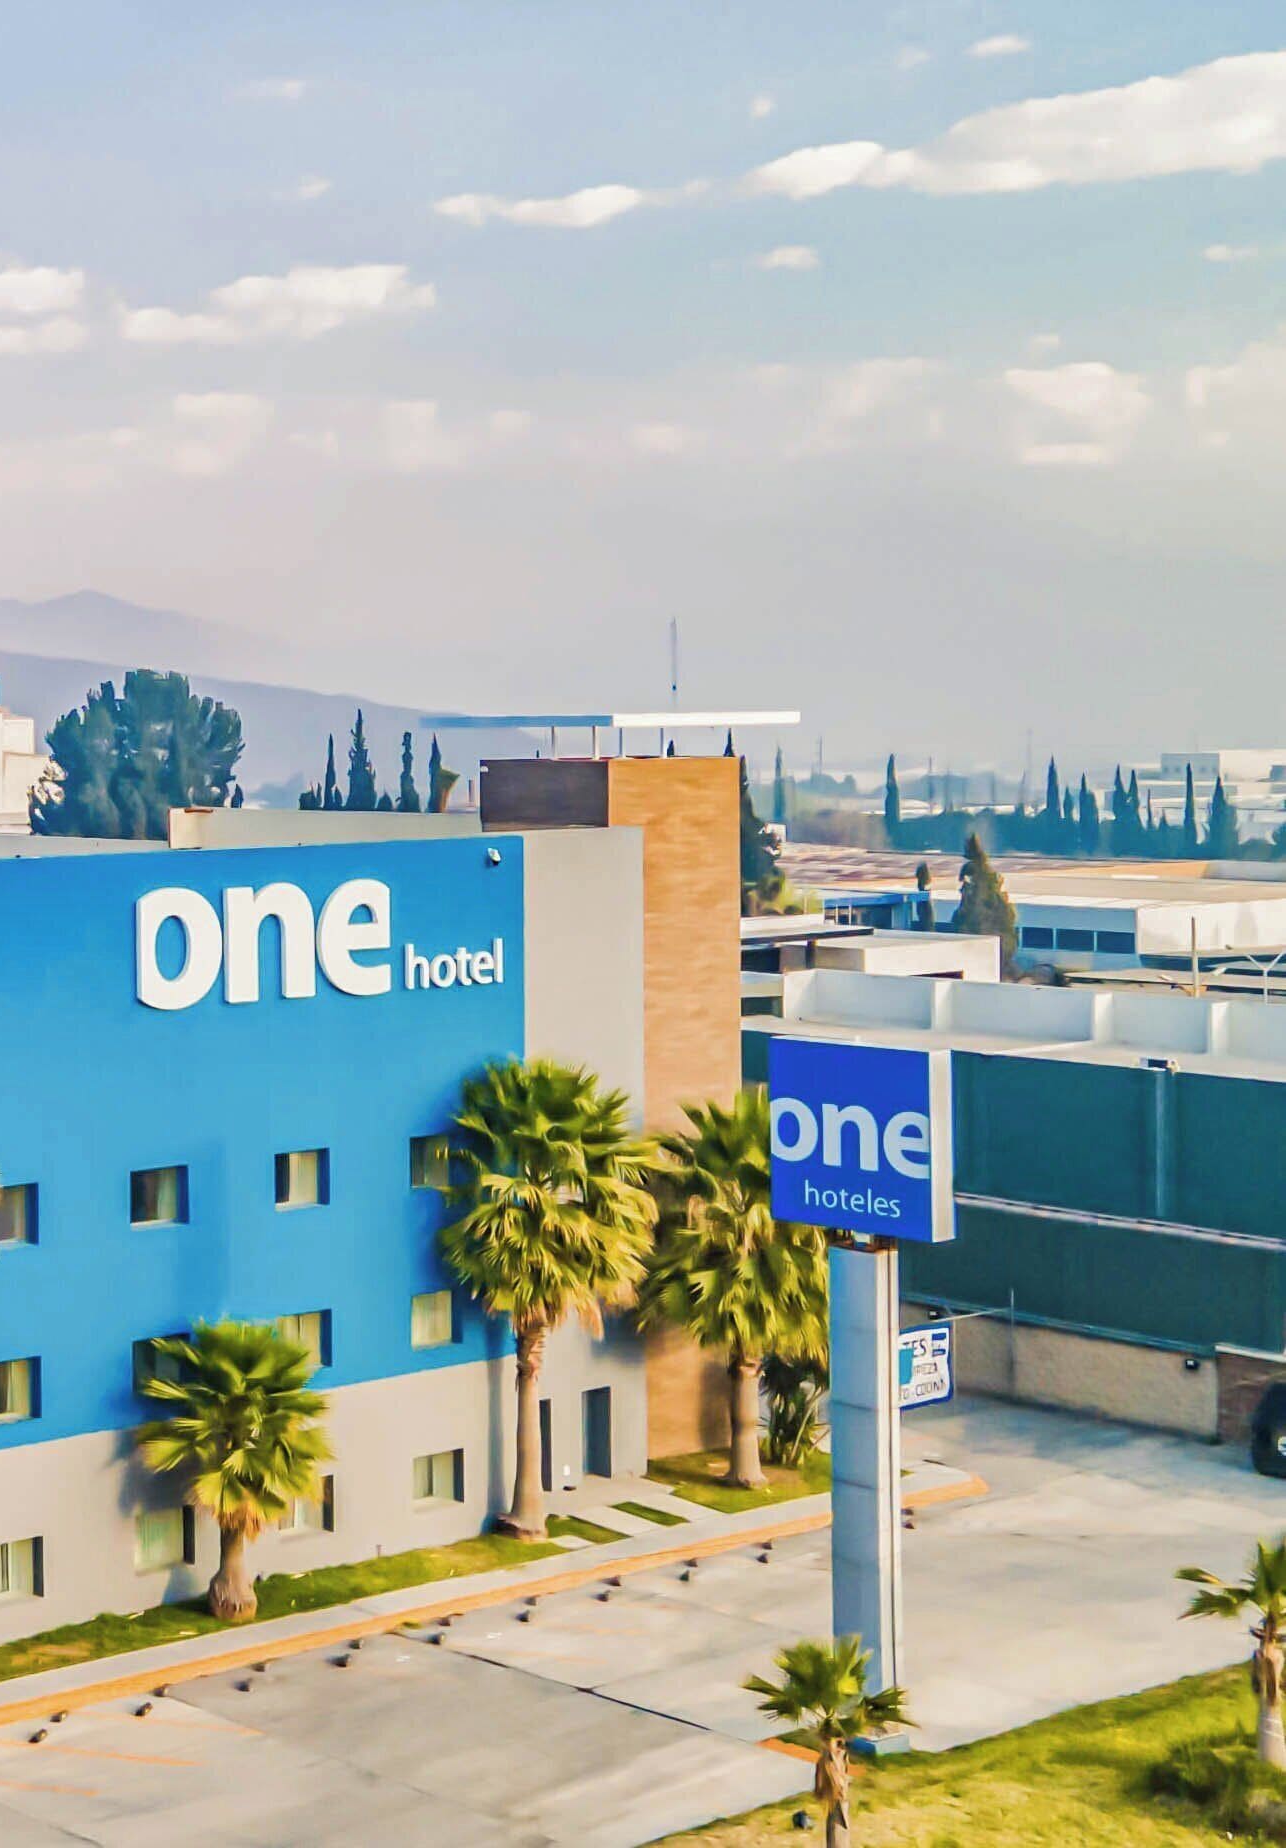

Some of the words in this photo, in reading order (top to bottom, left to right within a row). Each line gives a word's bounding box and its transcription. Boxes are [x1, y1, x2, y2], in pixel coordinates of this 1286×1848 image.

[136, 878, 391, 1010] one
[404, 937, 504, 990] hotel
[770, 1097, 931, 1180] one
[804, 1179, 901, 1218] hoteles
